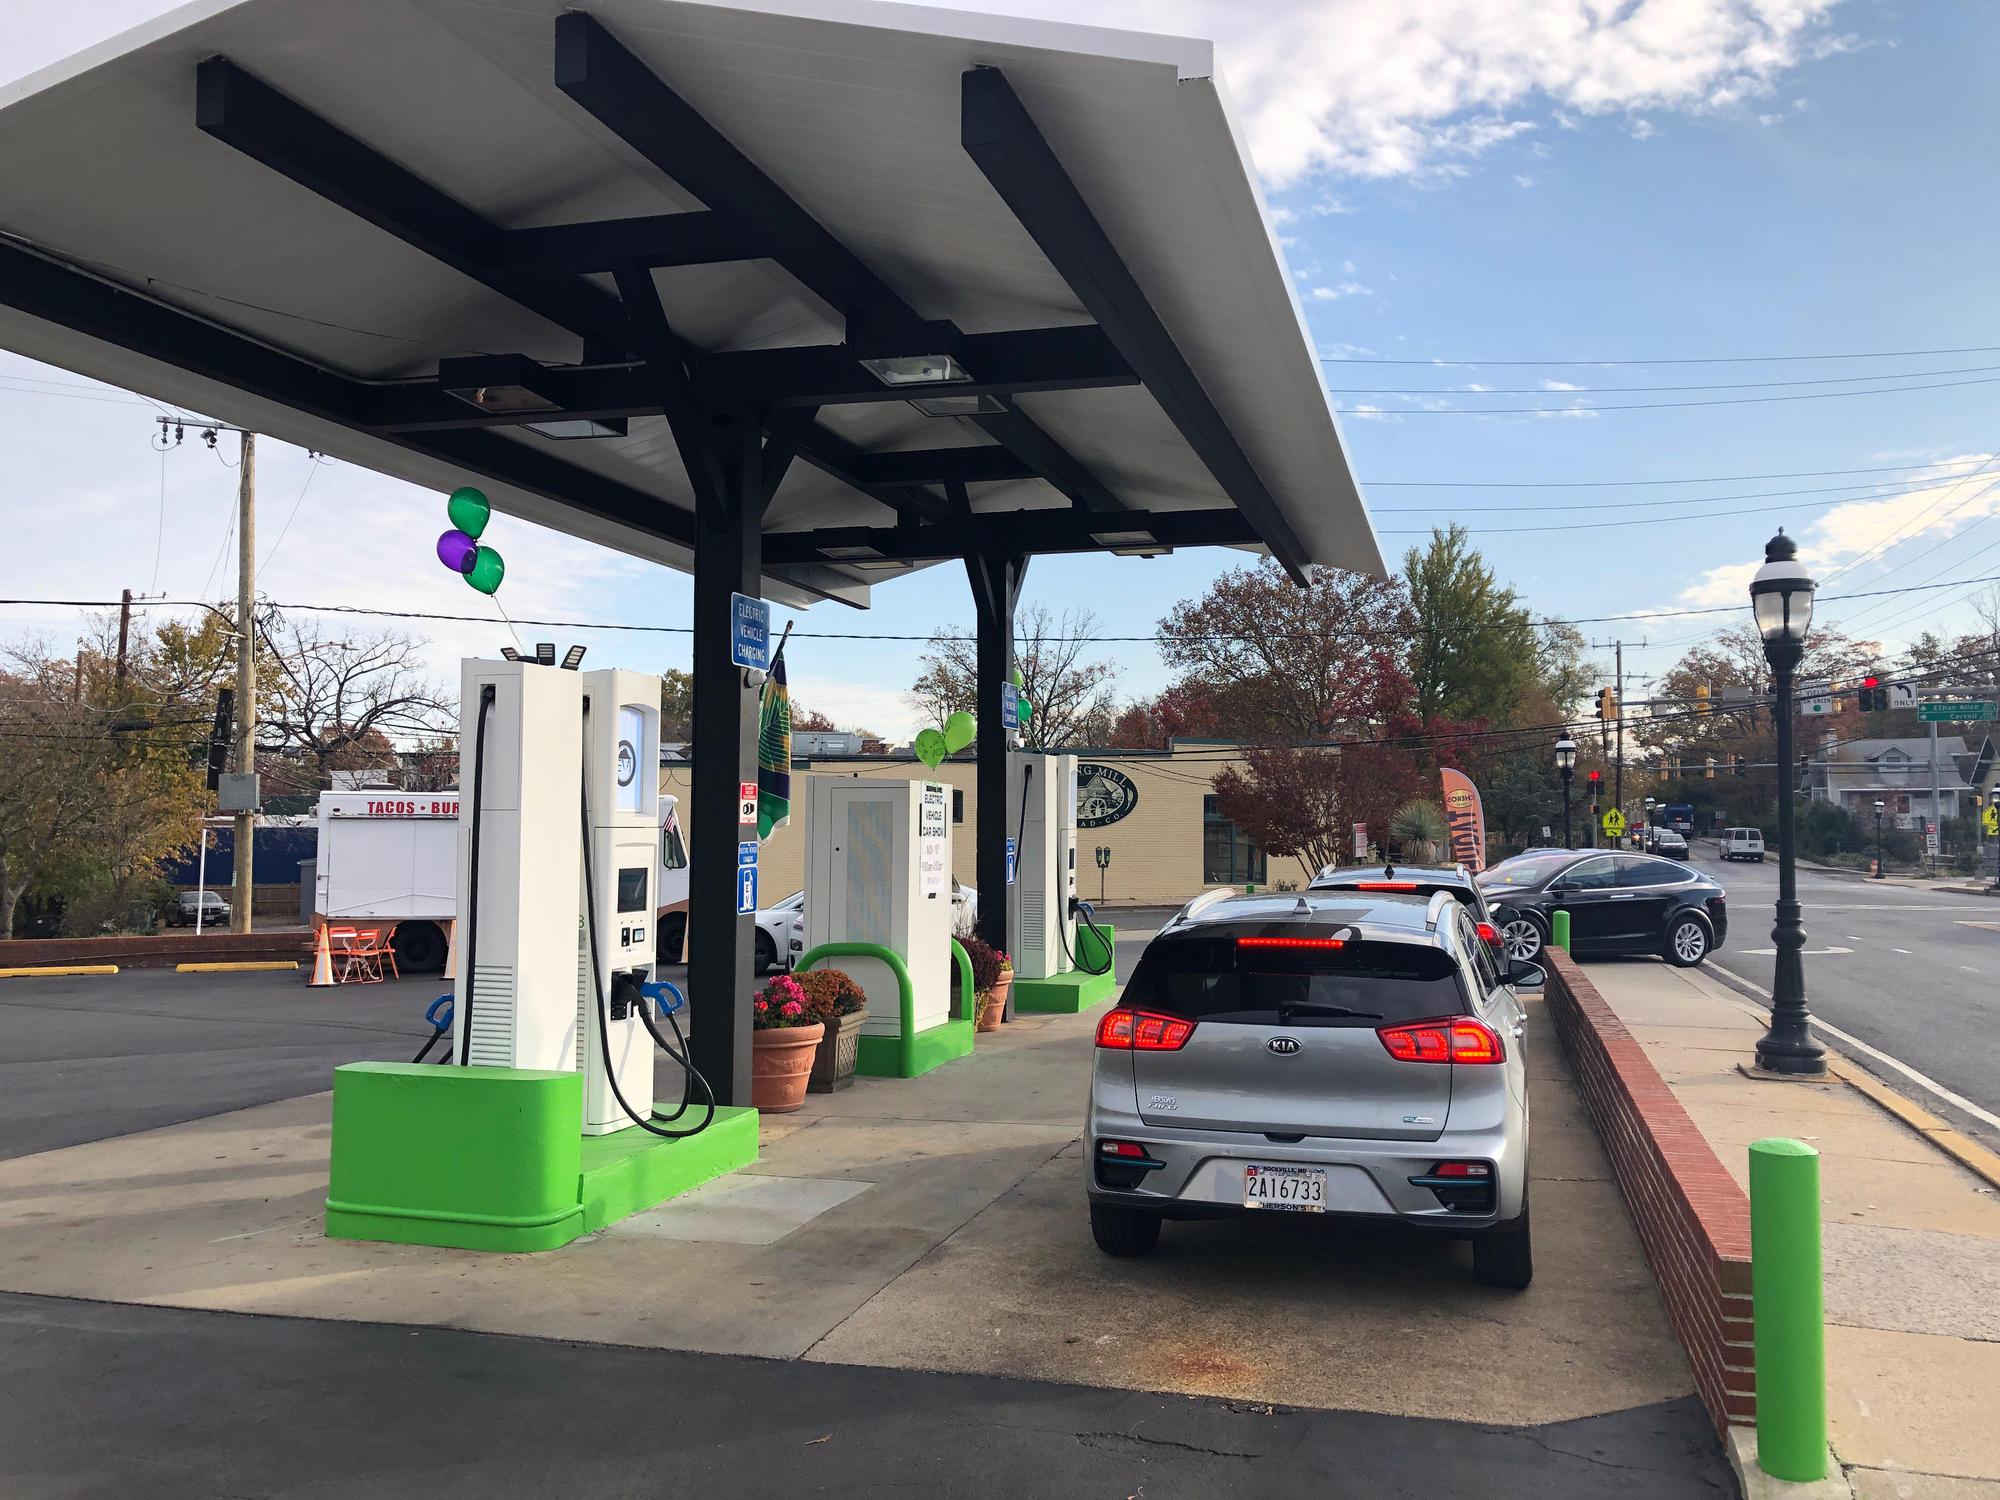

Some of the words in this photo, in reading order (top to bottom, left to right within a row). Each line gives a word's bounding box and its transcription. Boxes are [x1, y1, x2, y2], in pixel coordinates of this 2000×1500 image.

[738, 603, 765, 623] ELECTRIC
[740, 624, 763, 642] VEHICLE
[737, 643, 765, 662] CHARGING
[1098, 767, 1127, 788] MILL
[924, 793, 943, 805] ELECTRIC
[367, 801, 415, 814] TACOS
[926, 810, 942, 821] VEHICLE
[922, 826, 932, 837] CAR
[932, 826, 944, 837] SHOW
[1272, 1040, 1296, 1051] KIA
[1248, 1177, 1322, 1201] 2A16733
